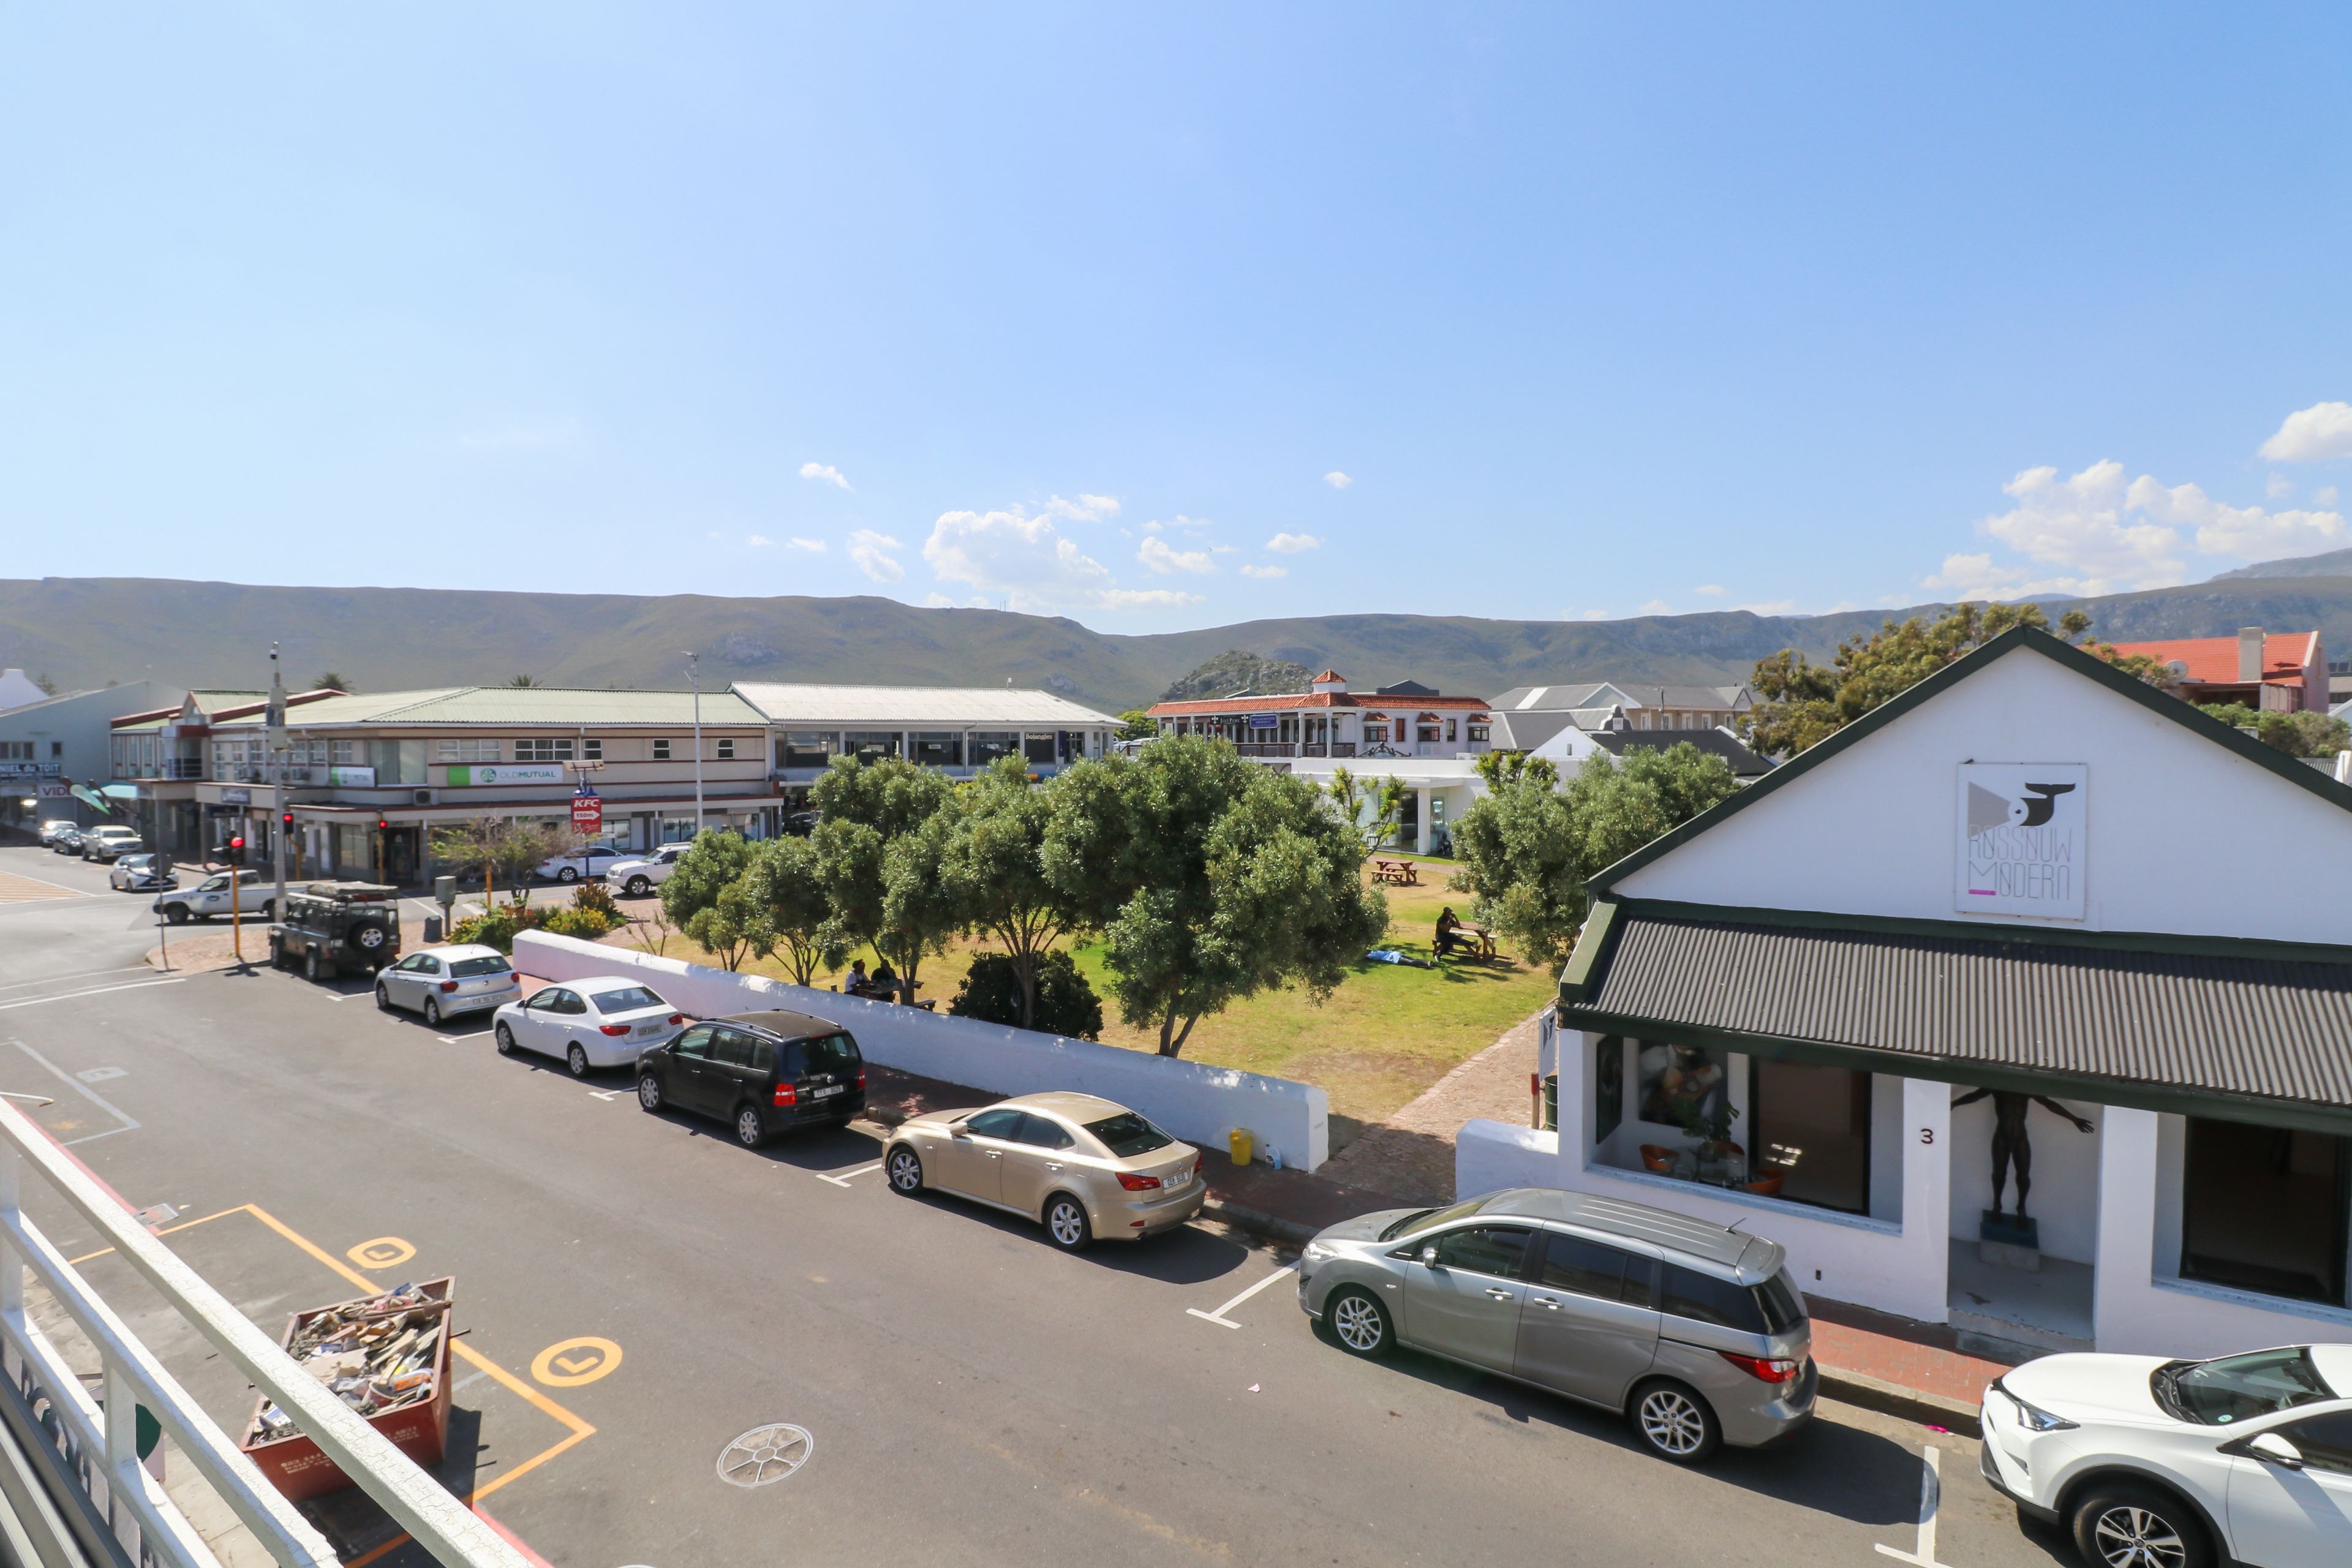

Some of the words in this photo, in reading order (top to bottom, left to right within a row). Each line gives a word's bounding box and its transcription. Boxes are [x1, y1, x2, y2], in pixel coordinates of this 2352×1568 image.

[573, 799, 599, 807] KFC
[1920, 1128, 1934, 1145] 3
[554, 1356, 599, 1374] L
